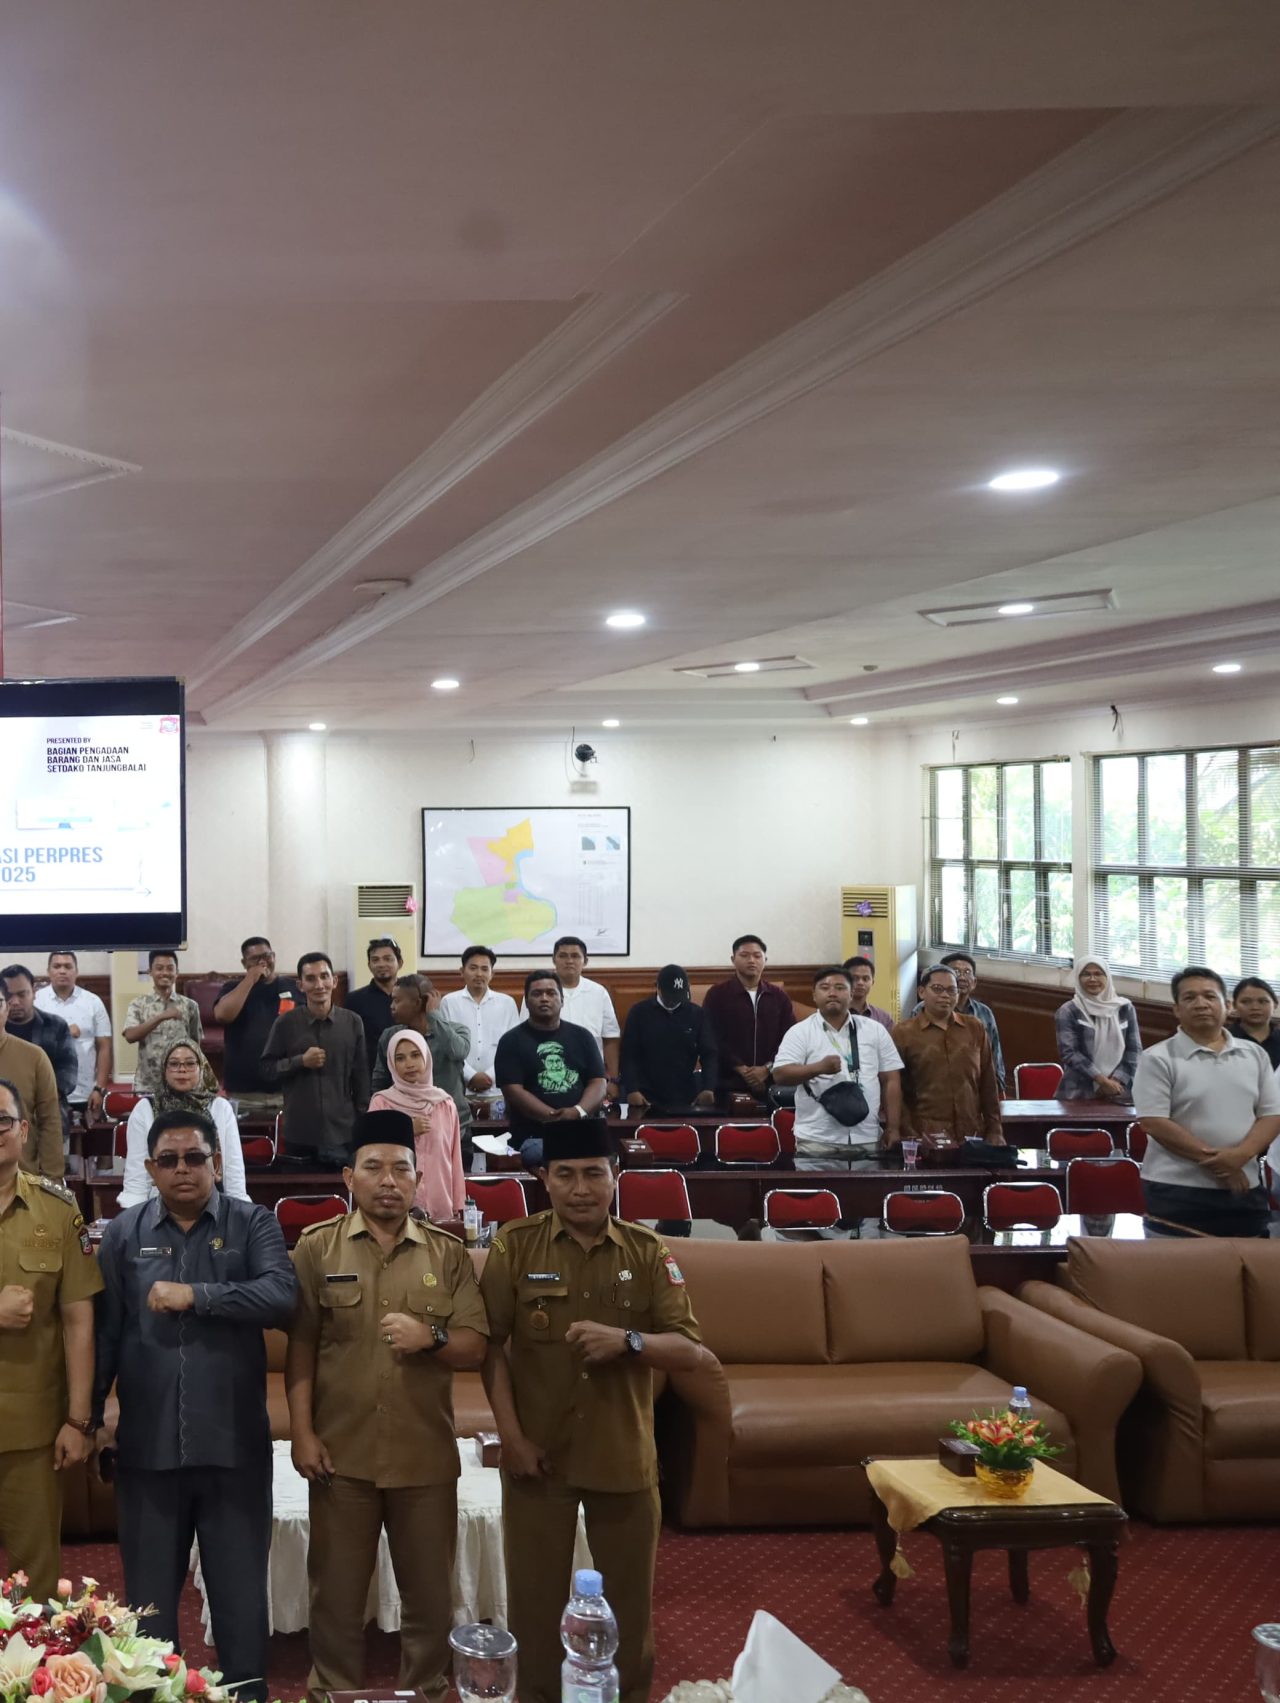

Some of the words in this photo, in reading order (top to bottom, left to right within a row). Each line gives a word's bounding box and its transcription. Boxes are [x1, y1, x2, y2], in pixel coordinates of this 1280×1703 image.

[47, 747, 77, 755] BAGIAN
[80, 746, 129, 754] PENGADAAN
[47, 756, 80, 764] BARANG
[83, 755, 99, 763] DAN
[102, 755, 121, 763] JASA
[47, 764, 84, 773] SETDAKO
[87, 763, 146, 772] TANJUNGBALAI
[24, 847, 103, 864] PERPRES
